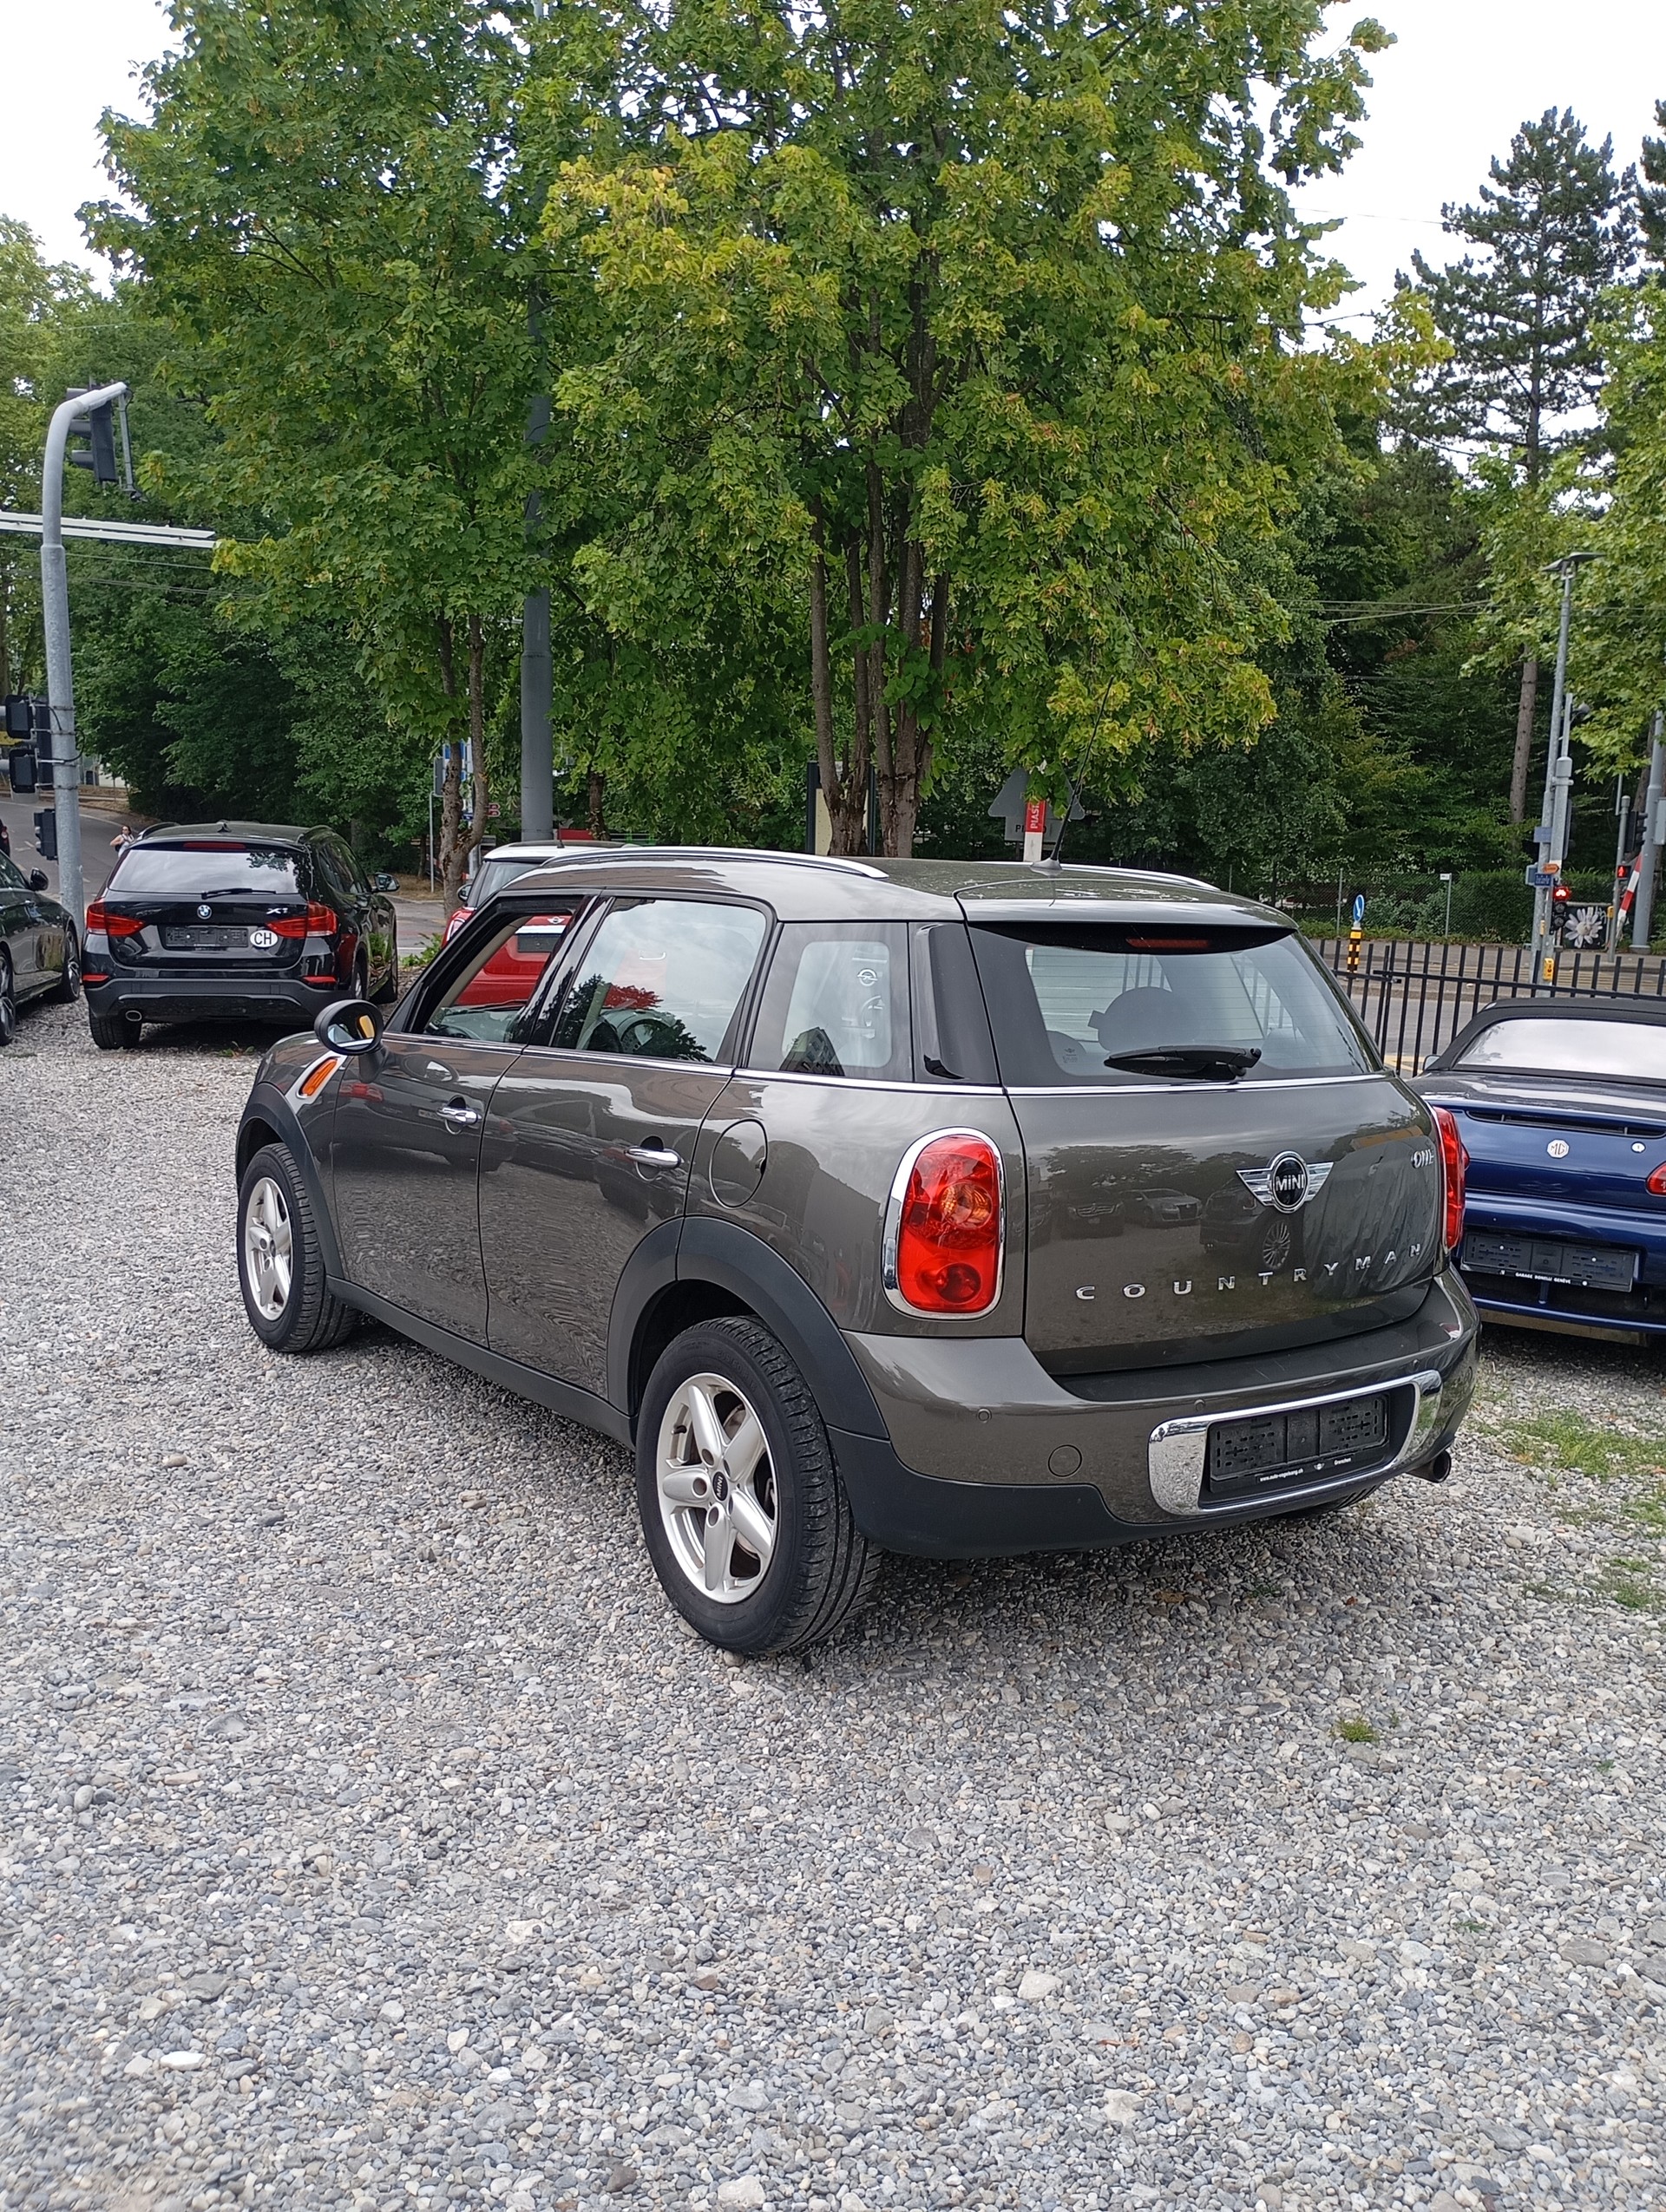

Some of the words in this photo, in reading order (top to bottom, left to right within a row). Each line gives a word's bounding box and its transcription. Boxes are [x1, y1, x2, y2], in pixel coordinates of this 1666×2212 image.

[254, 933, 273, 946] CH
[1413, 1149, 1434, 1169] ONE
[1275, 1175, 1305, 1191] MINI
[1075, 1243, 1422, 1300] COUNTRYMAN
